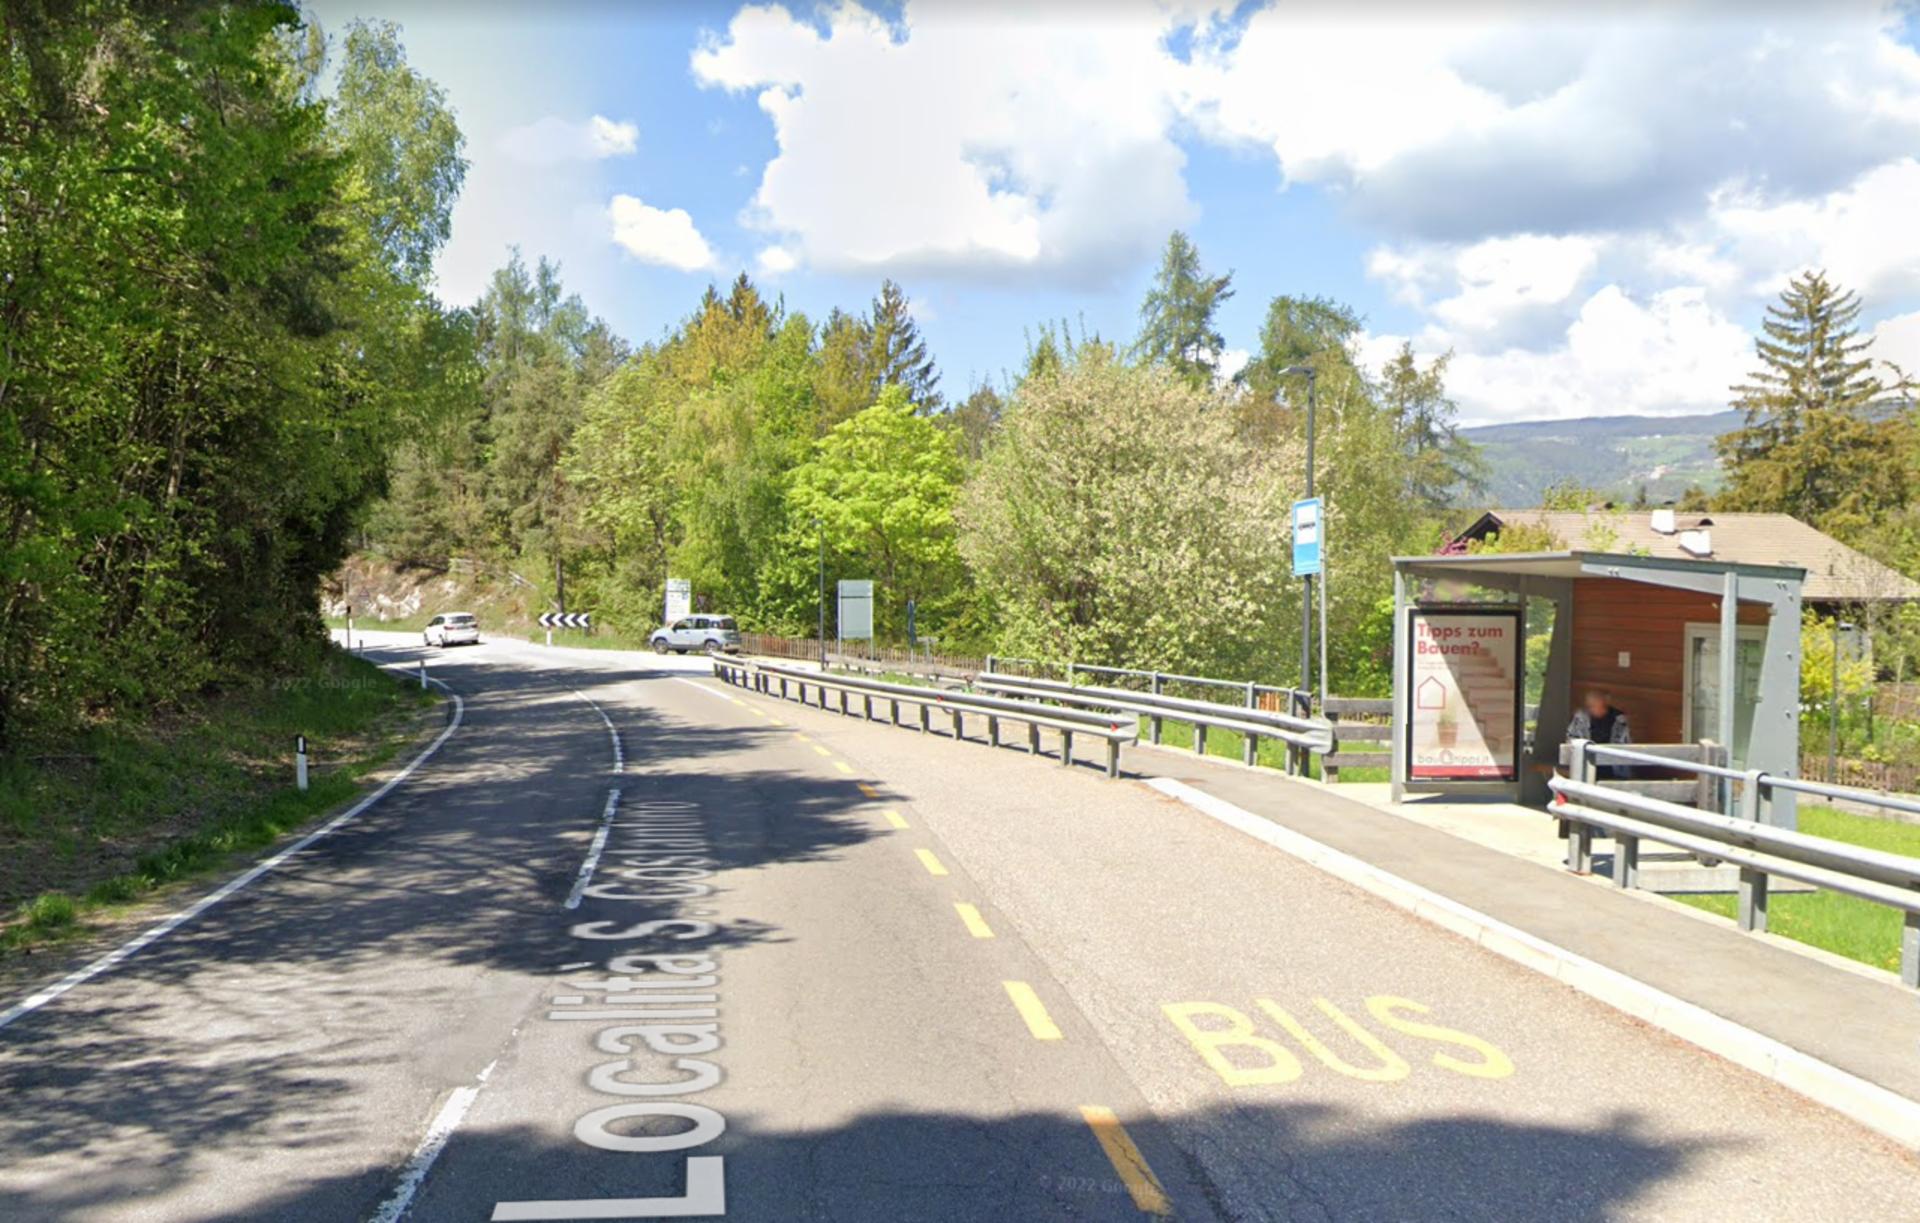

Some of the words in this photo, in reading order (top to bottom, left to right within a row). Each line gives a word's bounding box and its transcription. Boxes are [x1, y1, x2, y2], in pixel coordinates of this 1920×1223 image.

[1418, 624, 1462, 640] Tipps
[1468, 627, 1503, 637] zum
[1418, 641, 1480, 655] Bauen?
[1161, 996, 1515, 1087] BUS
